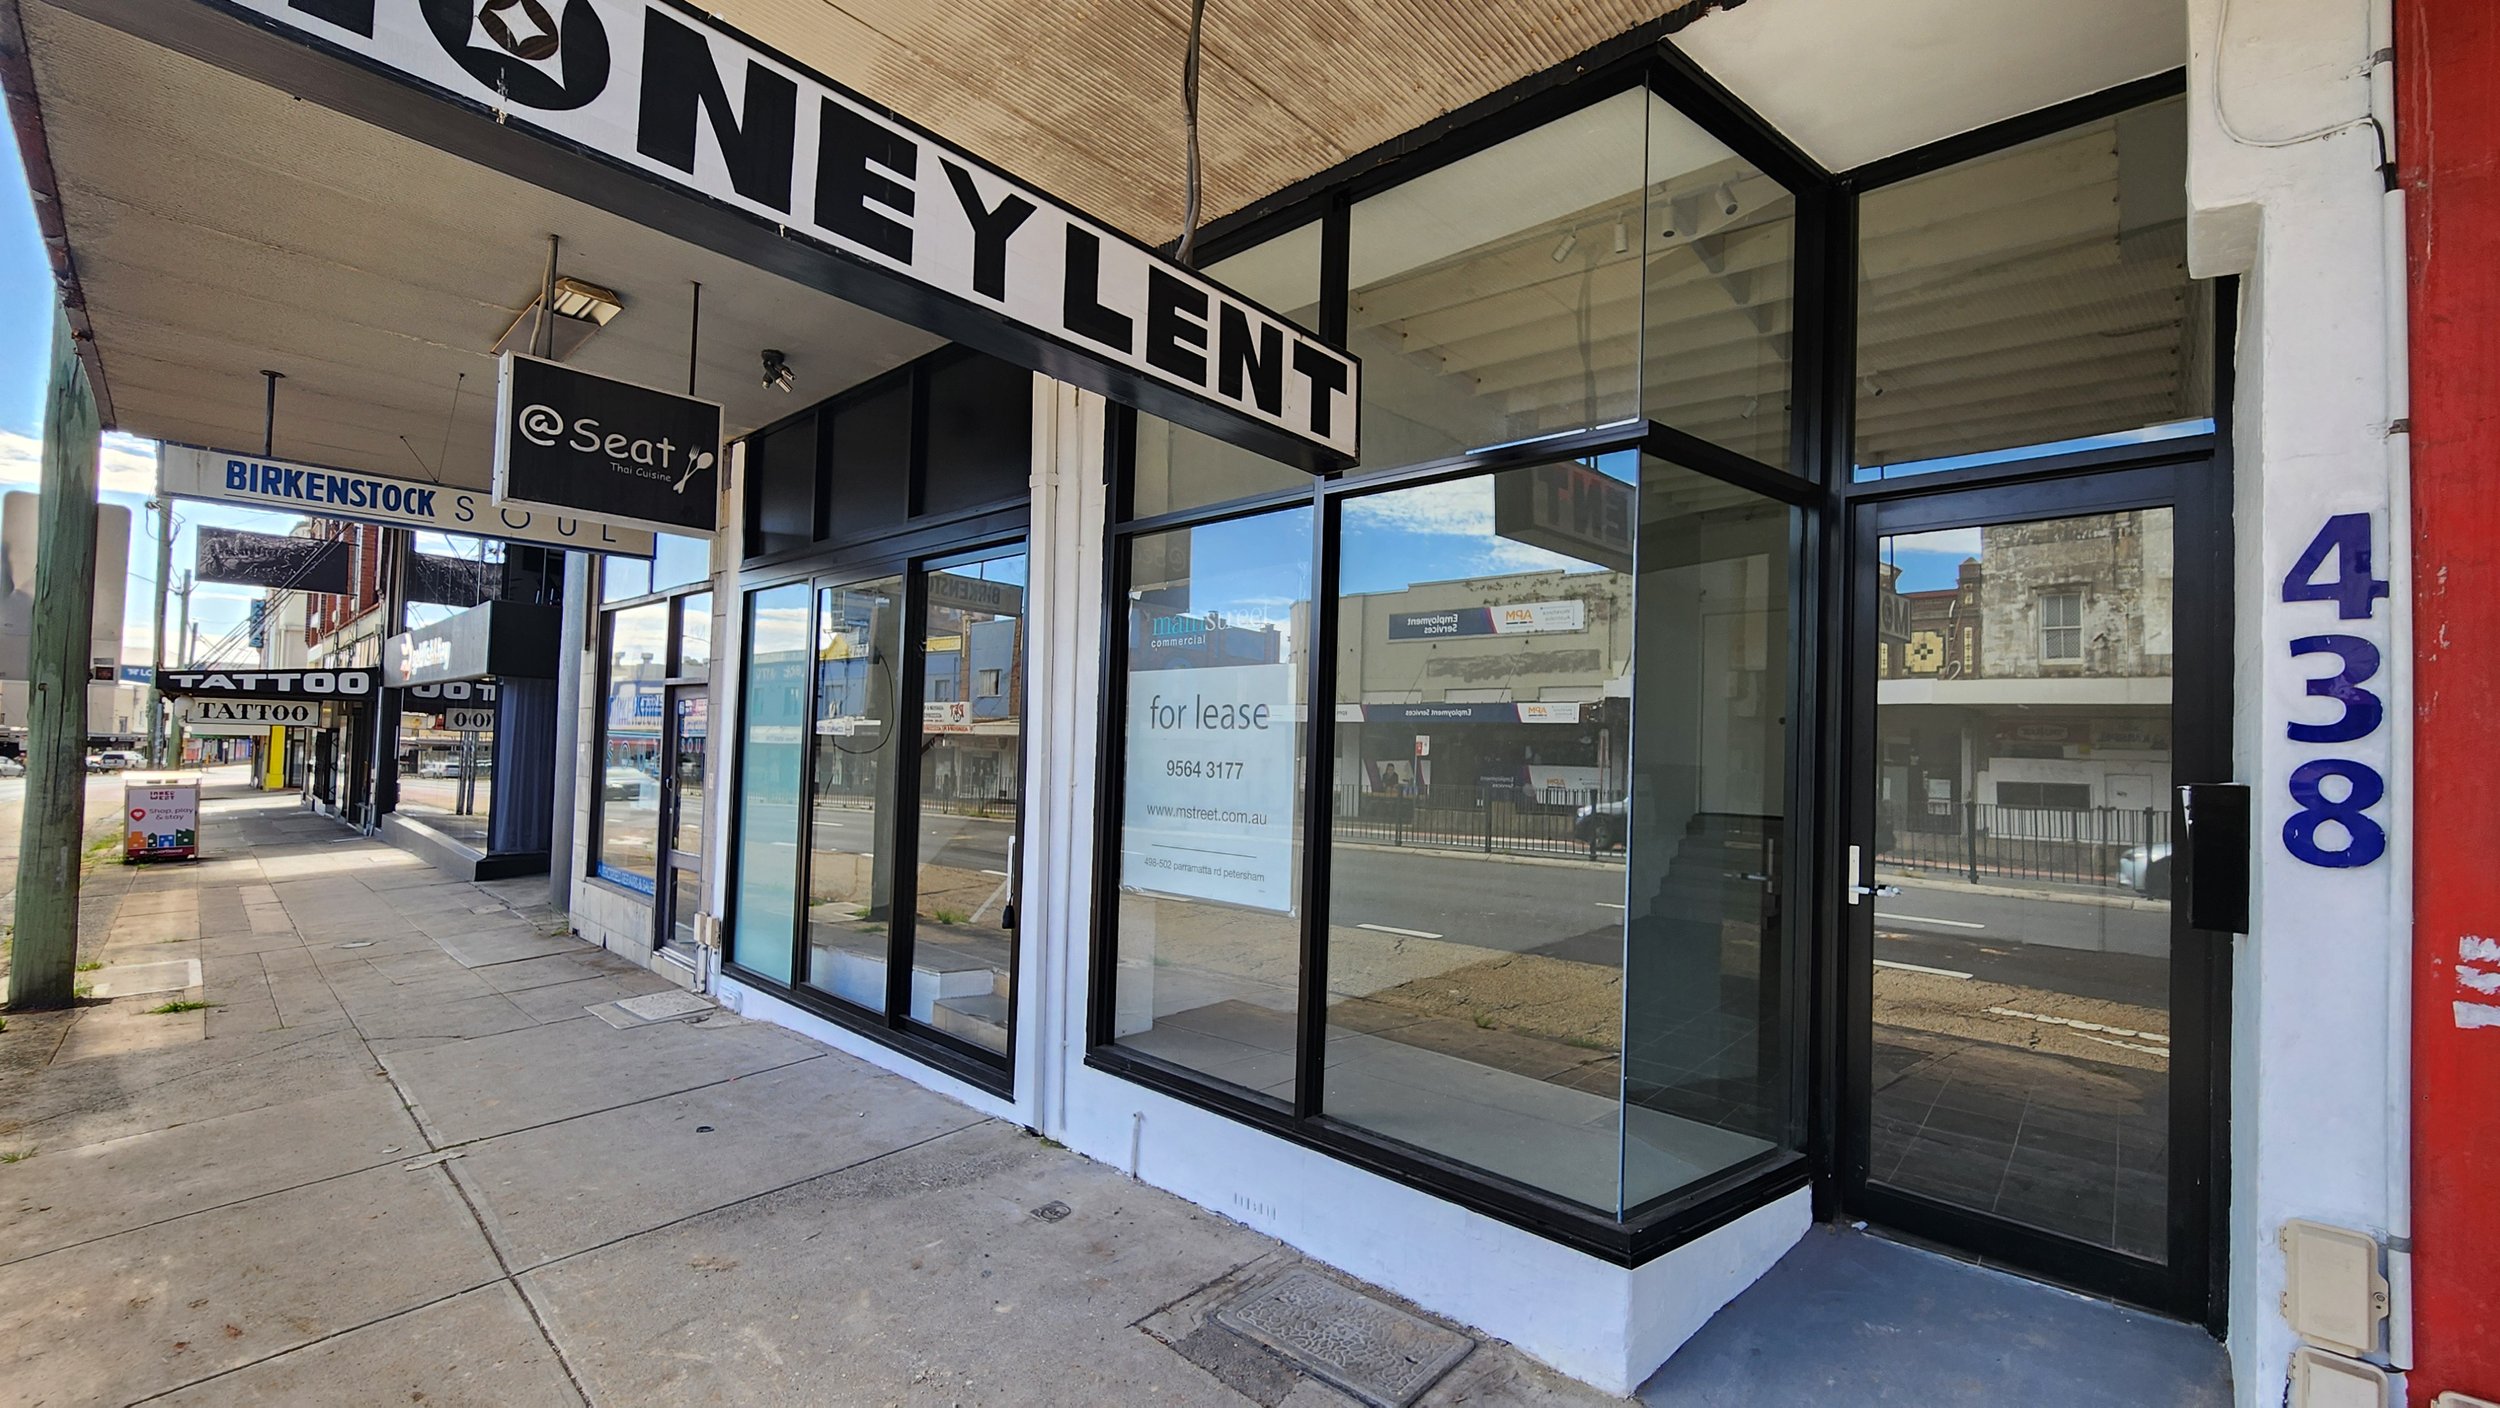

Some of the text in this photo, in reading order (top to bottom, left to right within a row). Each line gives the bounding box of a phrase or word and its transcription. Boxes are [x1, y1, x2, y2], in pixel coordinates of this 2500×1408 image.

[610, 462, 671, 482] Thai Cuisine
[226, 460, 436, 517] BIRKENSTOCK
[1151, 635, 1206, 648] commercial
[169, 672, 369, 695] TATTOO
[2282, 511, 2391, 869] 438
[198, 702, 309, 722] TATTOO
[1150, 694, 1270, 730] for lease
[1166, 760, 1244, 780] 9564 3177
[175, 807, 194, 815] play
[1146, 804, 1268, 826] www.mstreet.com.au
[1173, 862, 1212, 876] parramatta
[1213, 868, 1222, 876] rd
[1223, 869, 1265, 882] petersham
